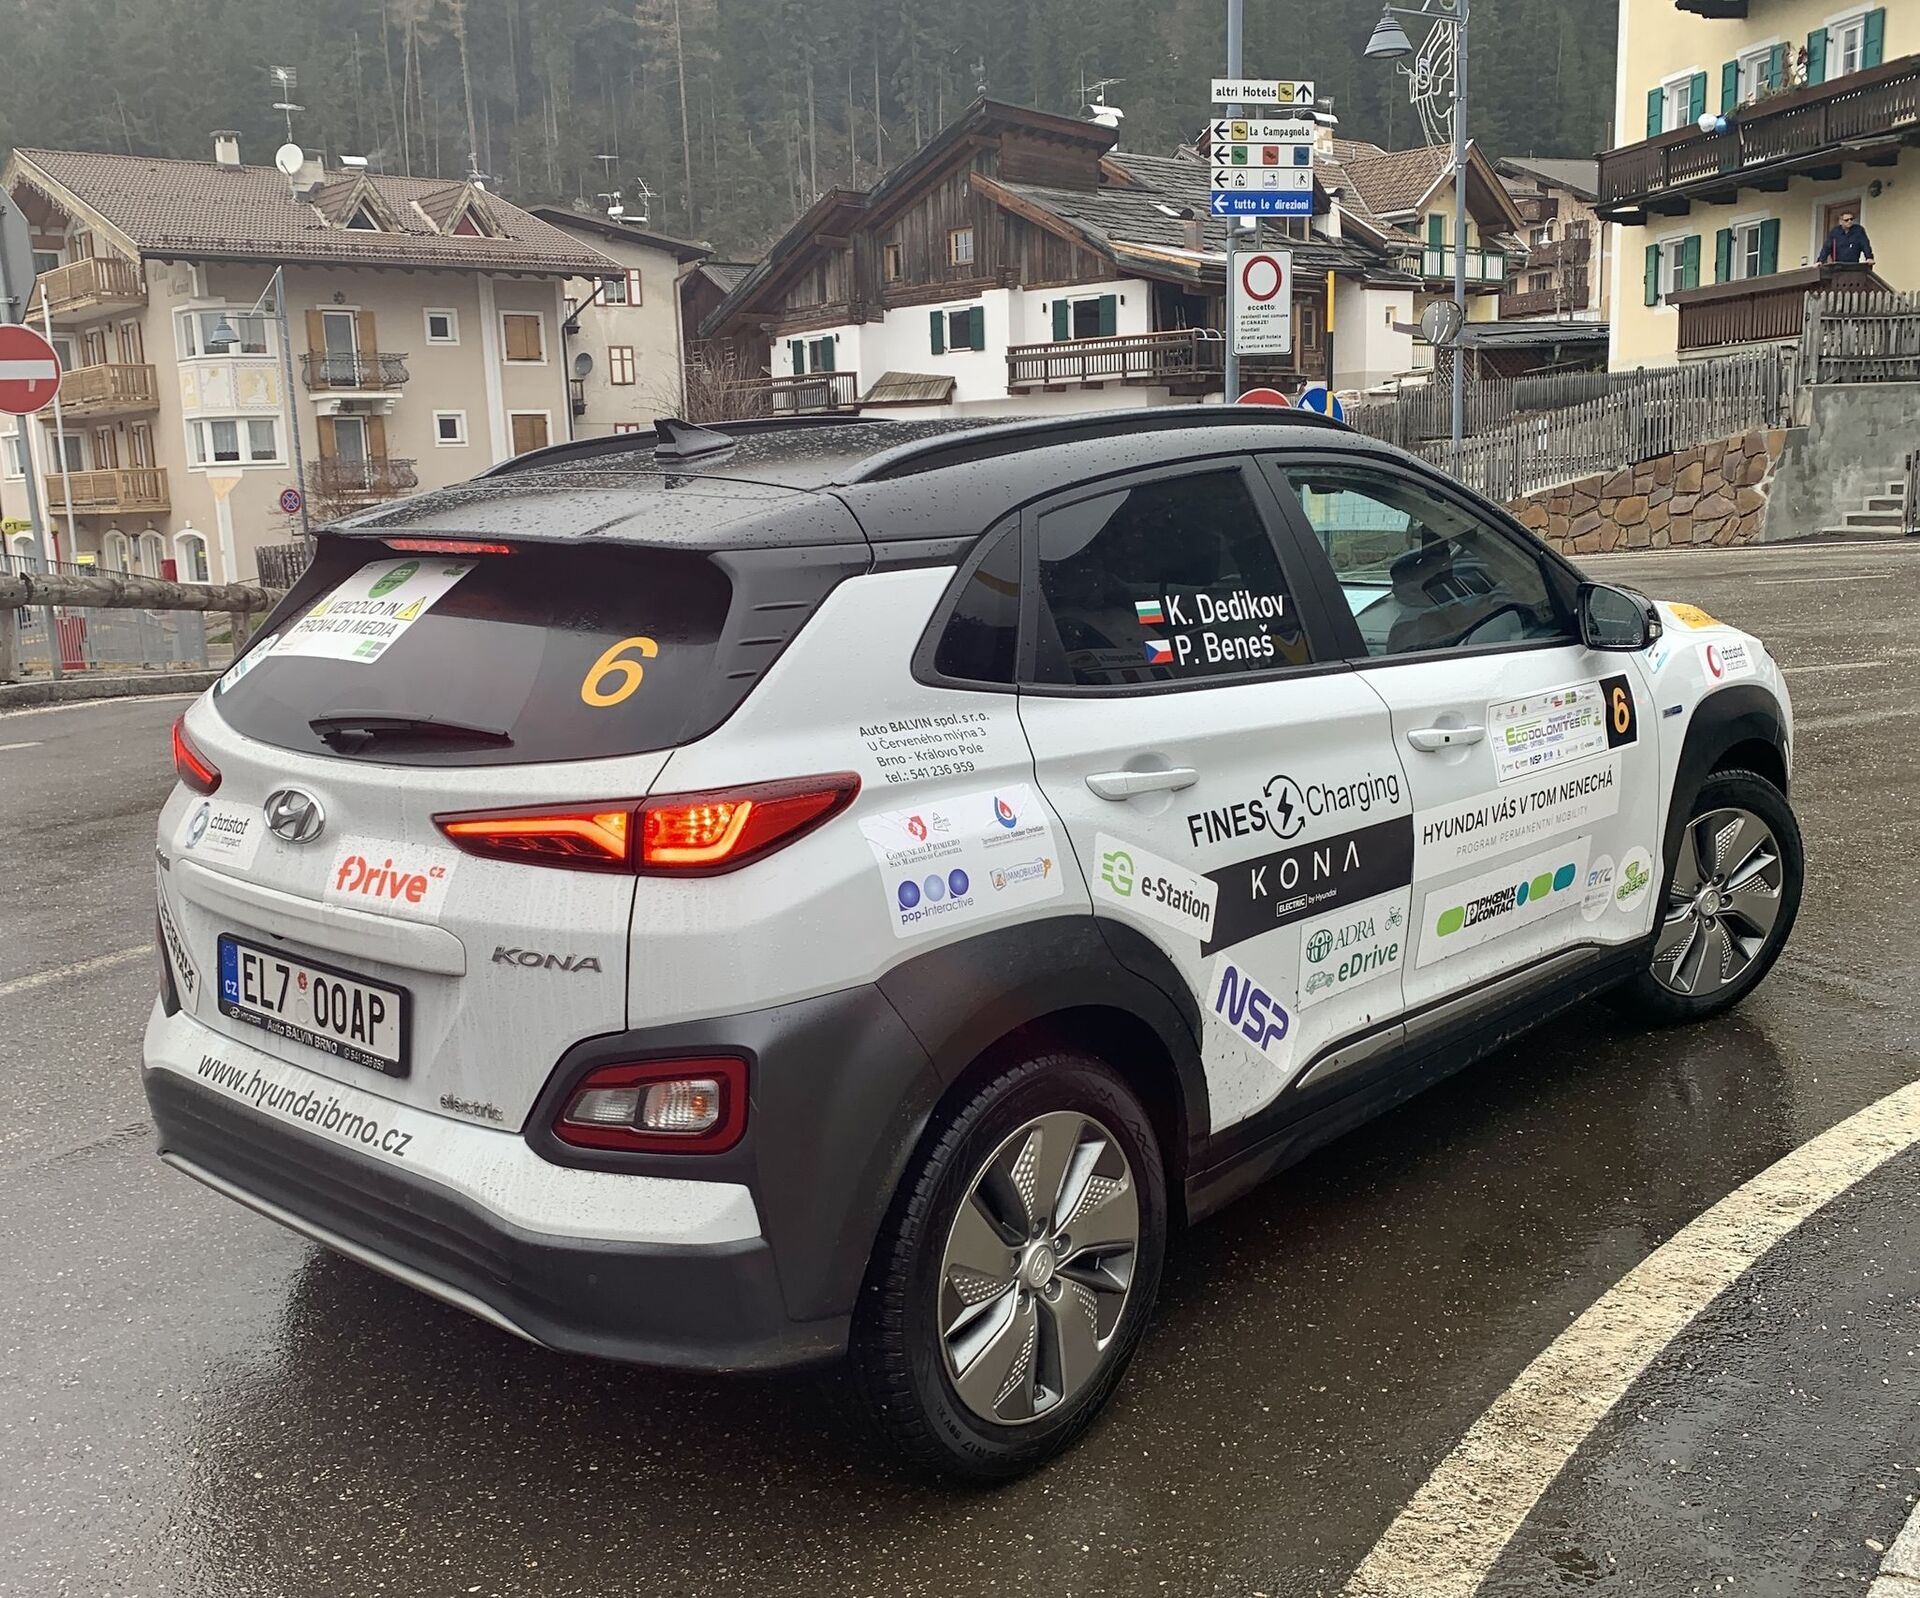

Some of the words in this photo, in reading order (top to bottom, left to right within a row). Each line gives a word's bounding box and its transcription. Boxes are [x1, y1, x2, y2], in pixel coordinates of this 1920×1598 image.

[1216, 86, 1238, 96] altri
[1243, 86, 1277, 97] Hotels
[1263, 126, 1310, 138] Campagnola
[1234, 199, 1256, 210] tutte
[1261, 199, 1270, 210] le
[1274, 199, 1309, 210] direzioni
[5, 522, 16, 530] PT
[328, 600, 385, 616] VEICOLO
[380, 600, 404, 616] IN
[1165, 594, 1194, 626] K.
[1196, 590, 1284, 624] Dedikov
[294, 620, 334, 634] PROVA
[332, 620, 348, 634] DI
[348, 622, 398, 638] MEDIA
[1174, 634, 1200, 666] P.
[1202, 624, 1274, 663] Beneš
[581, 636, 658, 707] 6
[1612, 686, 1630, 734] 6
[859, 724, 888, 737] Auto
[888, 717, 932, 732] BALVIN
[934, 714, 962, 728] spol.
[867, 742, 878, 752] U
[880, 732, 943, 750] Červeného
[944, 729, 978, 741] mlýna
[978, 727, 987, 736] 3
[876, 756, 906, 767] Brno
[914, 748, 958, 762] Královo
[958, 743, 984, 755] Pole
[1530, 754, 1542, 766] NSP
[885, 770, 910, 784] tel.:
[910, 768, 930, 780] 541
[930, 764, 952, 777] 236
[953, 760, 975, 772] 959
[1187, 800, 1266, 848] FINES
[1306, 772, 1400, 816] Charging
[1423, 807, 1488, 845] HYUNDAI
[1492, 796, 1516, 824] VÁS
[1520, 796, 1530, 814] V
[1530, 787, 1556, 811] TOM
[1560, 764, 1613, 801] NENECHÁ
[210, 812, 250, 834] christof
[1456, 836, 1497, 857] PROGRAM
[1500, 814, 1555, 843] PERMANENTNÍ
[1556, 804, 1588, 824] MOBILITY
[1251, 840, 1360, 900] KONA
[1616, 868, 1650, 900] GREEN
[1141, 876, 1210, 922] e-Station
[1279, 899, 1306, 913] ELECTRIC
[1308, 896, 1316, 904] by
[1316, 888, 1337, 902] Hyundai
[1478, 898, 1516, 922] CONTACT
[1334, 917, 1376, 950] ADRA
[492, 946, 602, 973] KONA
[1338, 942, 1398, 982] eDrive
[225, 979, 238, 996] CZ
[242, 952, 290, 1013] EL7
[1215, 966, 1289, 1052] NSP
[266, 1019, 284, 1034] Auto
[286, 1025, 314, 1046] BALVIN
[314, 1036, 338, 1054] BRNO
[198, 1054, 414, 1157] www.hyundaibrno.cz
[440, 1092, 504, 1121] electric
